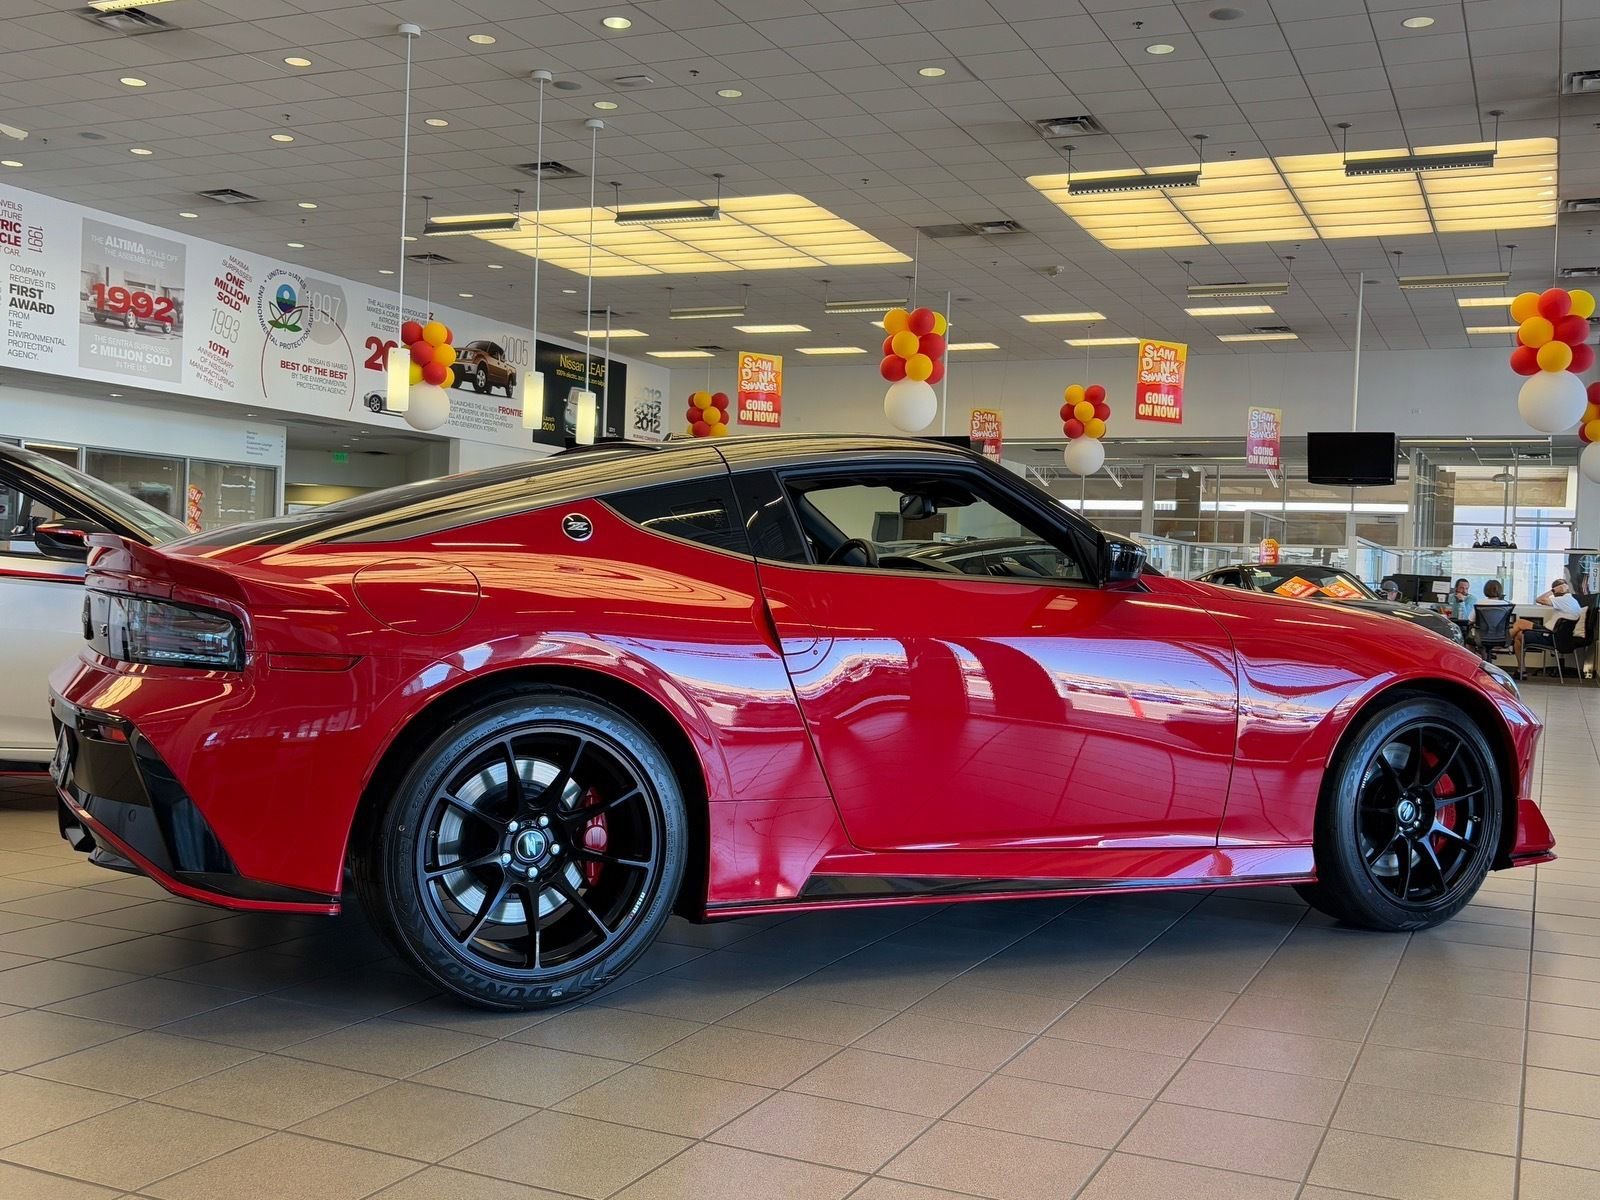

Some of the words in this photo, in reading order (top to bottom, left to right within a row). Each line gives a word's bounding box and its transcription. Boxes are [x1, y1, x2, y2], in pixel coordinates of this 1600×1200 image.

[28, 226, 43, 253] 1991
[105, 236, 144, 254] ALTIMA
[10, 264, 46, 278] COMPANY
[222, 259, 252, 283] SURPASSES
[229, 255, 249, 272] MAXIMA
[10, 274, 44, 287] RECEIVES
[45, 281, 56, 290] ITS
[225, 272, 245, 290] ONE
[9, 284, 44, 299] FIRST
[214, 277, 250, 305] MILLION
[9, 297, 55, 315] AWARD
[92, 283, 174, 323] 1992
[216, 291, 243, 313] SOLD.
[8, 311, 30, 320] FROM
[257, 285, 278, 346] ENVIRONMENTAL
[280, 328, 311, 350] PROTECTION
[8, 320, 22, 329] THE
[211, 307, 240, 344] 1993
[8, 329, 66, 346] ENVIRONMENTAL
[8, 339, 54, 353] PROTECTION
[208, 340, 230, 358] 10TH
[501, 334, 529, 366] 2005
[1144, 344, 1175, 361] SLAM
[7, 349, 39, 361] AGENCY.
[90, 344, 97, 354] 2
[100, 345, 143, 362] MILLION
[146, 354, 173, 367] SOLD
[198, 346, 234, 370] ANNIVERSARY
[308, 357, 325, 367] NISSAN
[200, 356, 208, 366] OF
[208, 359, 228, 375] NISSAN
[280, 360, 300, 372] BEST
[302, 364, 312, 373] OF
[314, 366, 327, 376] THE
[327, 368, 348, 380] BEST
[560, 354, 585, 373] Nissan
[588, 363, 606, 378] EAF
[744, 357, 772, 372] SLAM
[189, 359, 235, 388] MANUFACTURING
[203, 375, 214, 387] THE
[291, 372, 298, 380] BY
[299, 373, 308, 382] THE
[309, 375, 347, 388] ENVIRONMENTAL
[297, 382, 326, 393] PROTECTION
[746, 399, 773, 411] GOING
[1145, 392, 1174, 405] GOING
[498, 406, 524, 418] FRONTIE
[740, 410, 753, 420] ON
[754, 411, 778, 423] NOW!
[974, 411, 995, 422] SLAM
[1138, 403, 1152, 416] ON
[1154, 405, 1180, 419] NOW!
[1252, 410, 1274, 422] SLAM
[983, 445, 995, 454] ING
[1253, 447, 1273, 456] GOING
[1249, 455, 1258, 465] ON
[1259, 456, 1278, 465] NOW!
